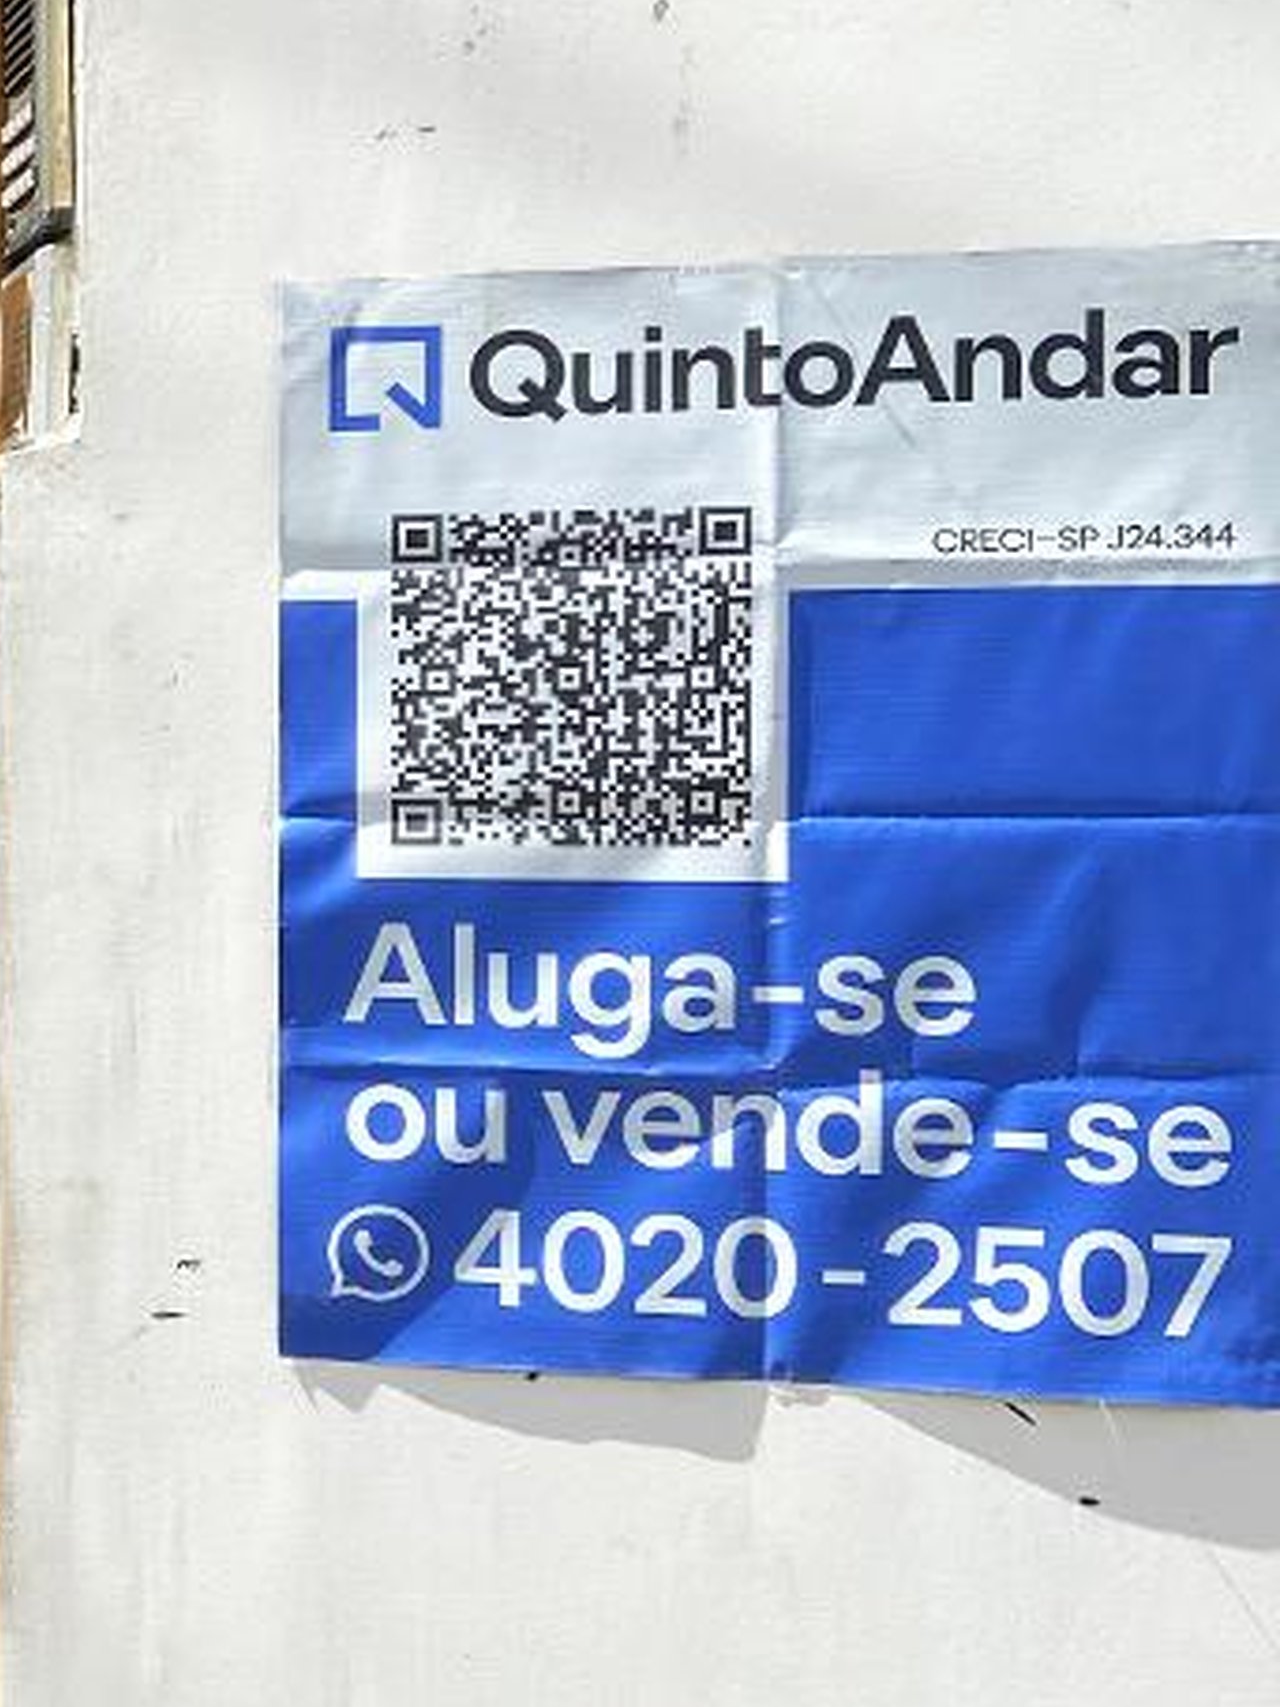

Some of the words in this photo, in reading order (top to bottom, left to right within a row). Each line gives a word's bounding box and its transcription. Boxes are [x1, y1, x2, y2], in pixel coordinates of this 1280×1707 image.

[470, 308, 1239, 422] QuintoAndar
[931, 524, 1100, 554] CRECI-SP
[1105, 521, 1239, 551] J24.344
[343, 922, 977, 1059] Aluga-se
[345, 1079, 508, 1164] ou
[543, 1069, 1233, 1188] vende-se
